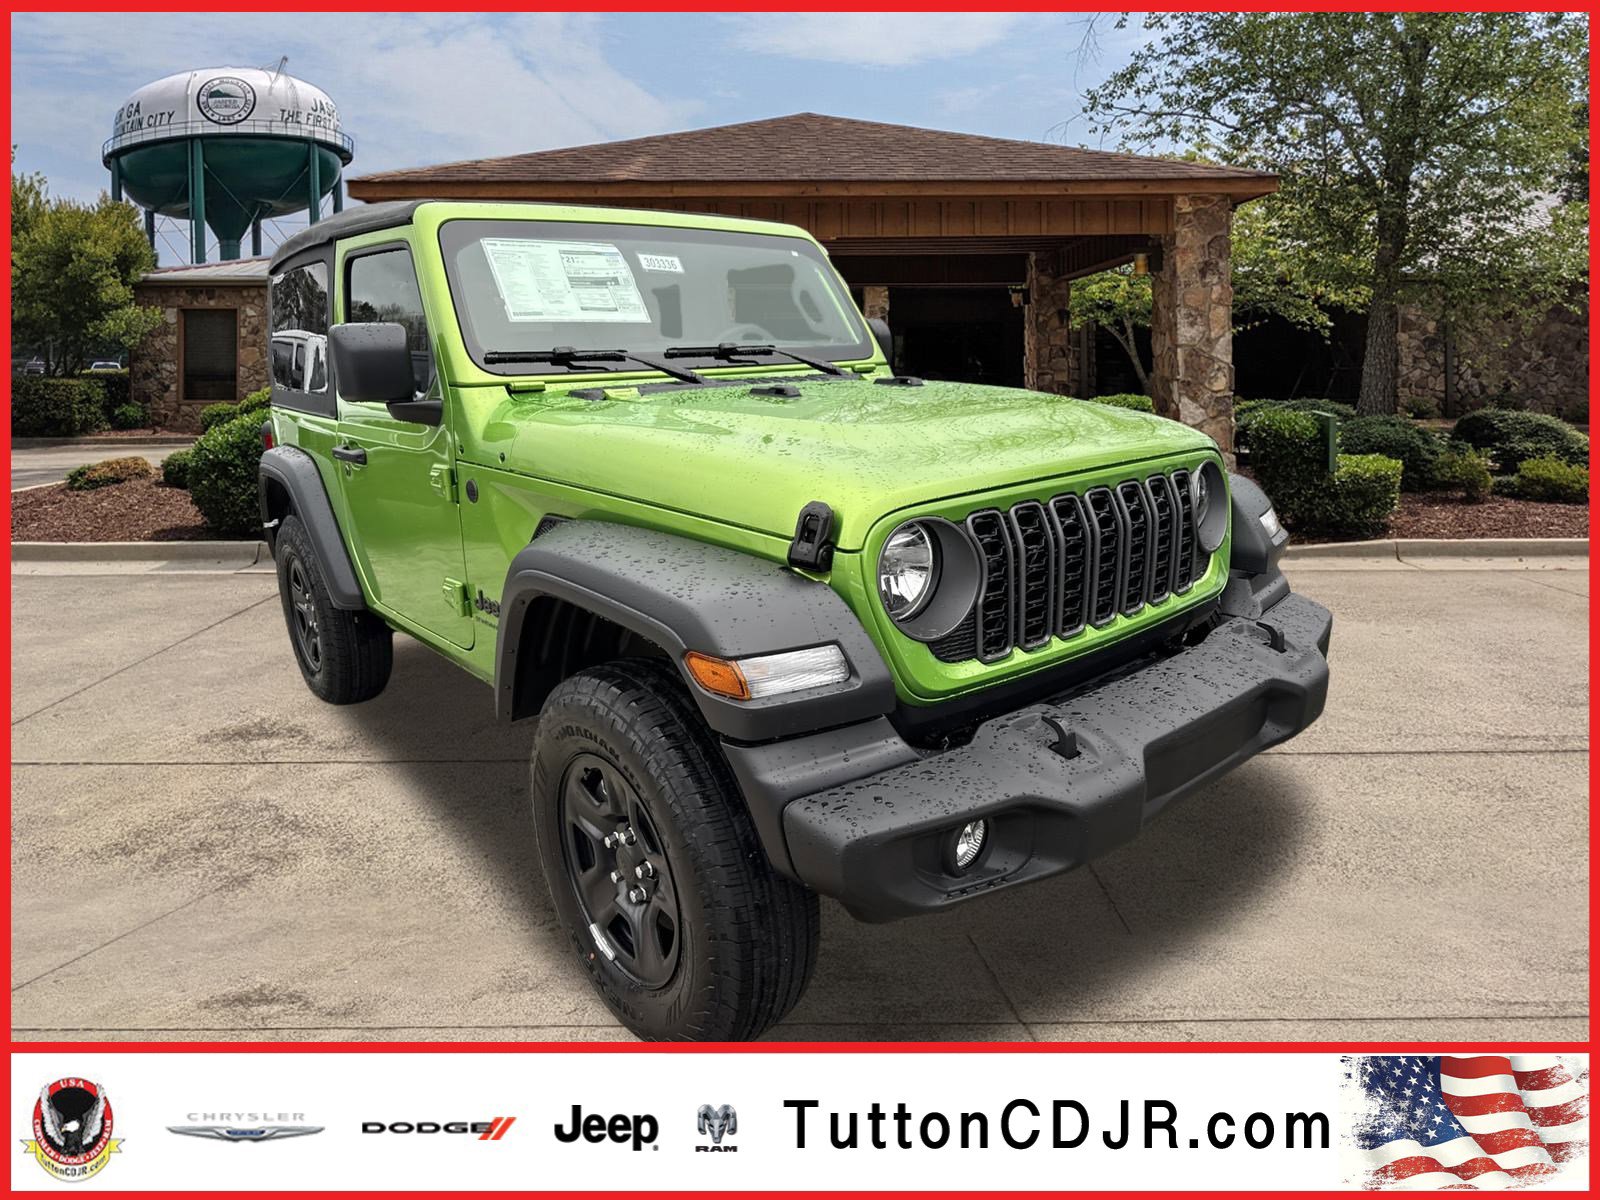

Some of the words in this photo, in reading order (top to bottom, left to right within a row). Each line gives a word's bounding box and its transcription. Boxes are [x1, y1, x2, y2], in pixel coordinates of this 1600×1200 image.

[126, 100, 141, 119] GA
[279, 108, 302, 123] THE
[147, 110, 176, 127] CITY
[643, 257, 678, 270] 303336
